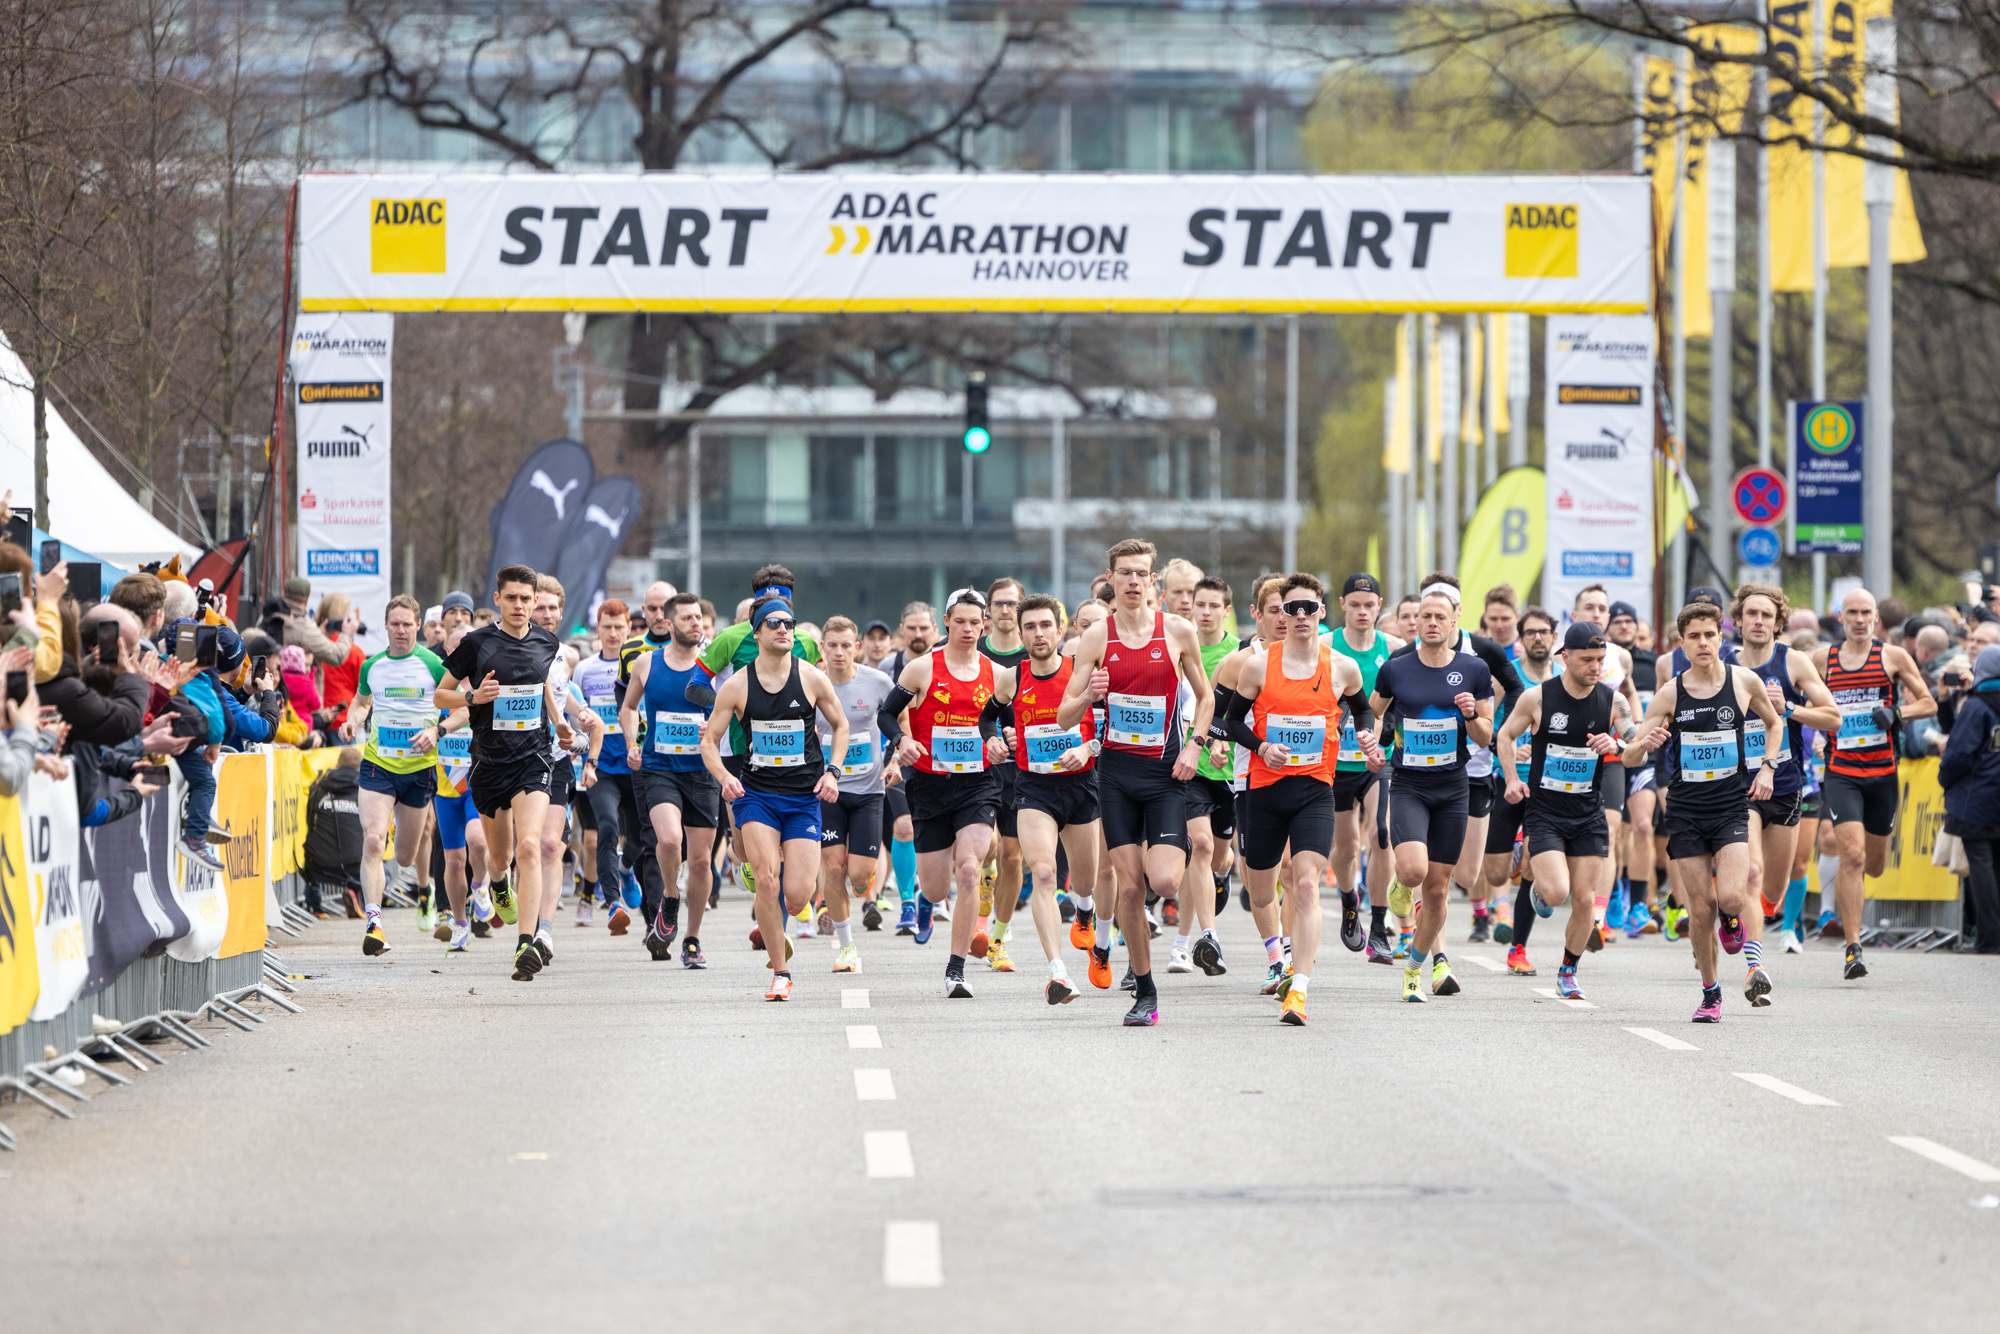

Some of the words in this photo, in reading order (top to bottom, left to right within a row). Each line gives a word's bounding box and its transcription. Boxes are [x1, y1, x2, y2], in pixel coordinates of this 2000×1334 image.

[830, 192, 938, 219] ADAC
[374, 201, 443, 225] ADAC
[1508, 204, 1577, 230] ADAC
[500, 205, 769, 267] START
[875, 224, 1128, 255] MARATHON
[1181, 207, 1451, 269] START
[972, 259, 1130, 282] HANNOVER
[296, 329, 328, 340] ADAC
[310, 339, 387, 351] MARATHON
[301, 383, 370, 402] Continental
[1820, 416, 1839, 440] H
[307, 440, 360, 458] PUMA
[1566, 443, 1619, 460] PUMA
[323, 497, 384, 511] Sparkasse
[323, 513, 381, 525] Hannover
[1501, 509, 1529, 555] B
[310, 551, 363, 565] ERDINGER
[506, 699, 536, 711] 12230
[1119, 709, 1154, 724] 12535
[1680, 709, 1695, 717] TEAM
[1845, 715, 1876, 728] 11682
[387, 730, 414, 740] 11719
[665, 725, 695, 736] 12432
[1278, 730, 1314, 744] 11697
[444, 740, 471, 750] 10801
[762, 735, 794, 746] 11483
[1037, 738, 1072, 753] 12966
[1414, 733, 1447, 745] 11493
[1746, 734, 1765, 747] 130
[944, 741, 974, 752] 11362
[1691, 746, 1725, 760] 12871
[1556, 760, 1588, 773] 10658
